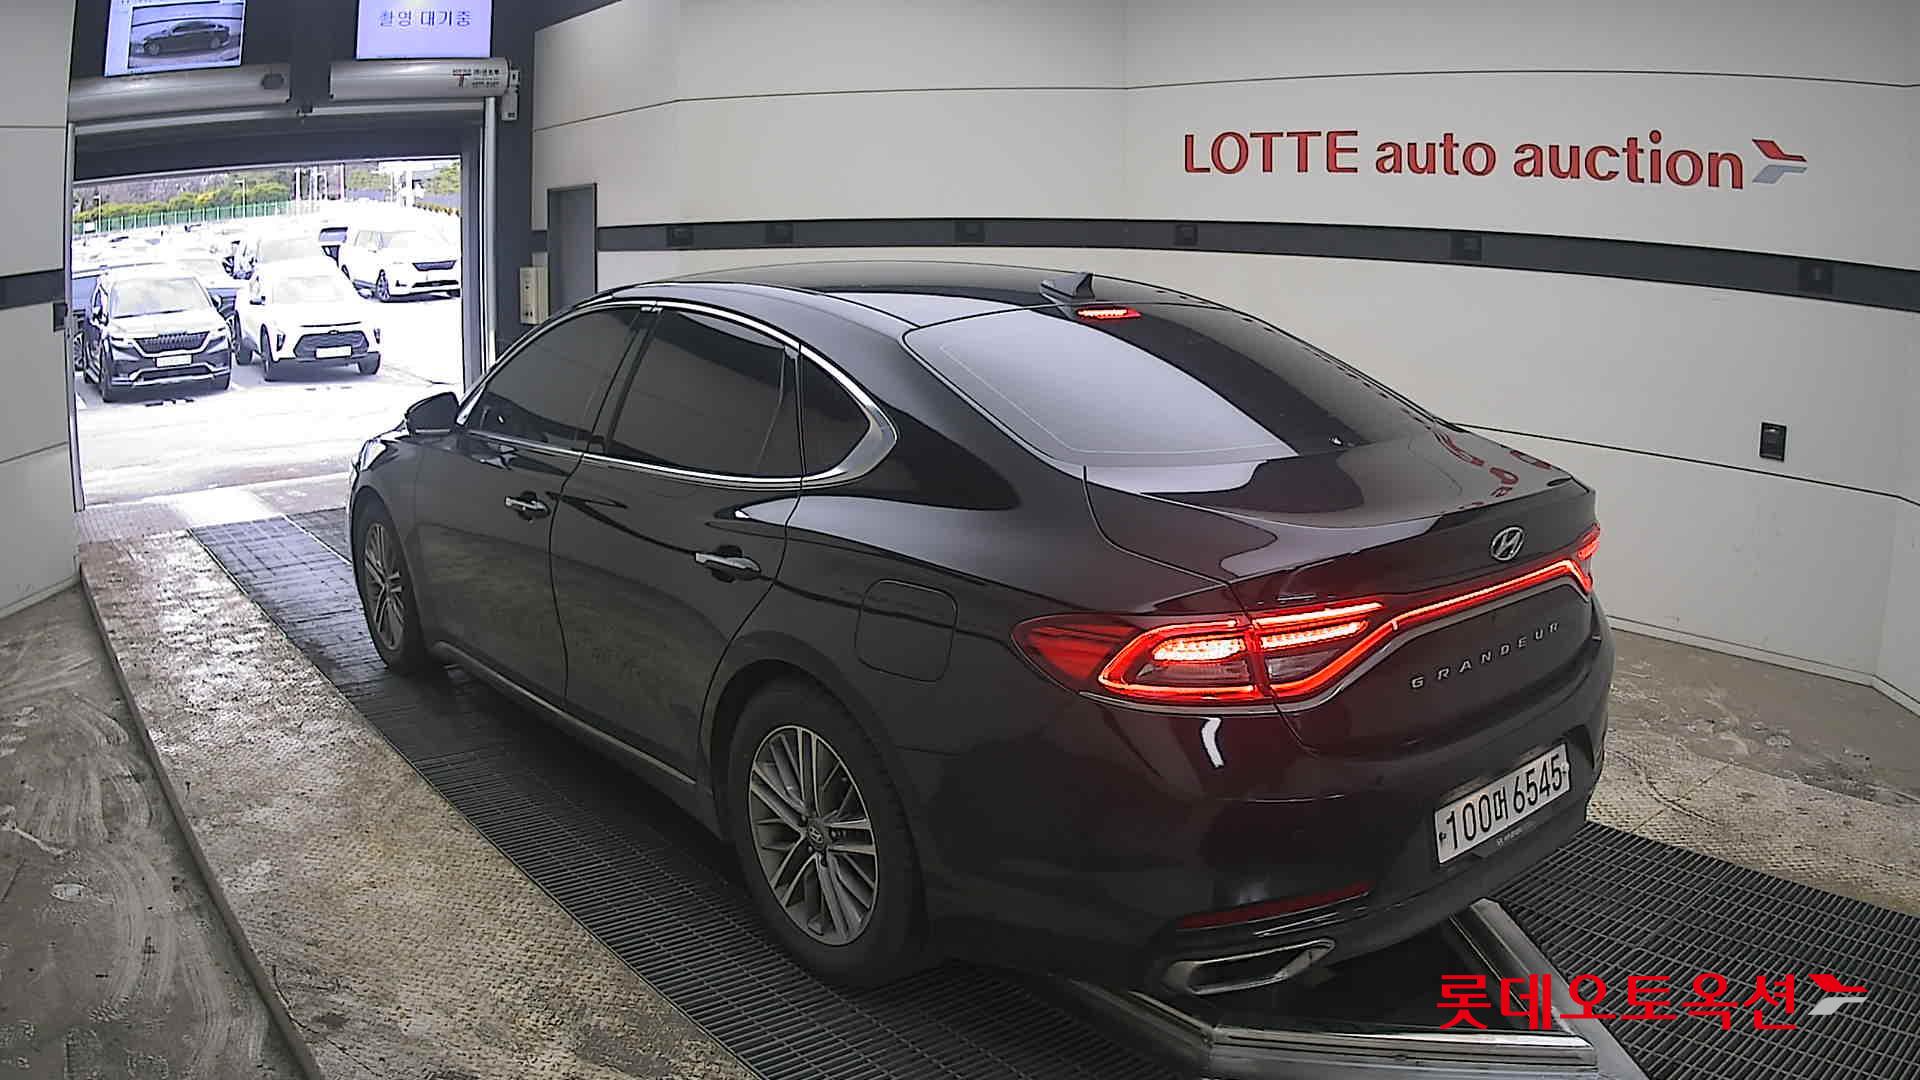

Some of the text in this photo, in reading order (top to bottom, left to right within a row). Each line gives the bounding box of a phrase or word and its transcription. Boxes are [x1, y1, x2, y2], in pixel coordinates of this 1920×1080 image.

[1184, 130, 1743, 189] LOTTE auto auction
[1411, 622, 1561, 689] GRANDEUR
